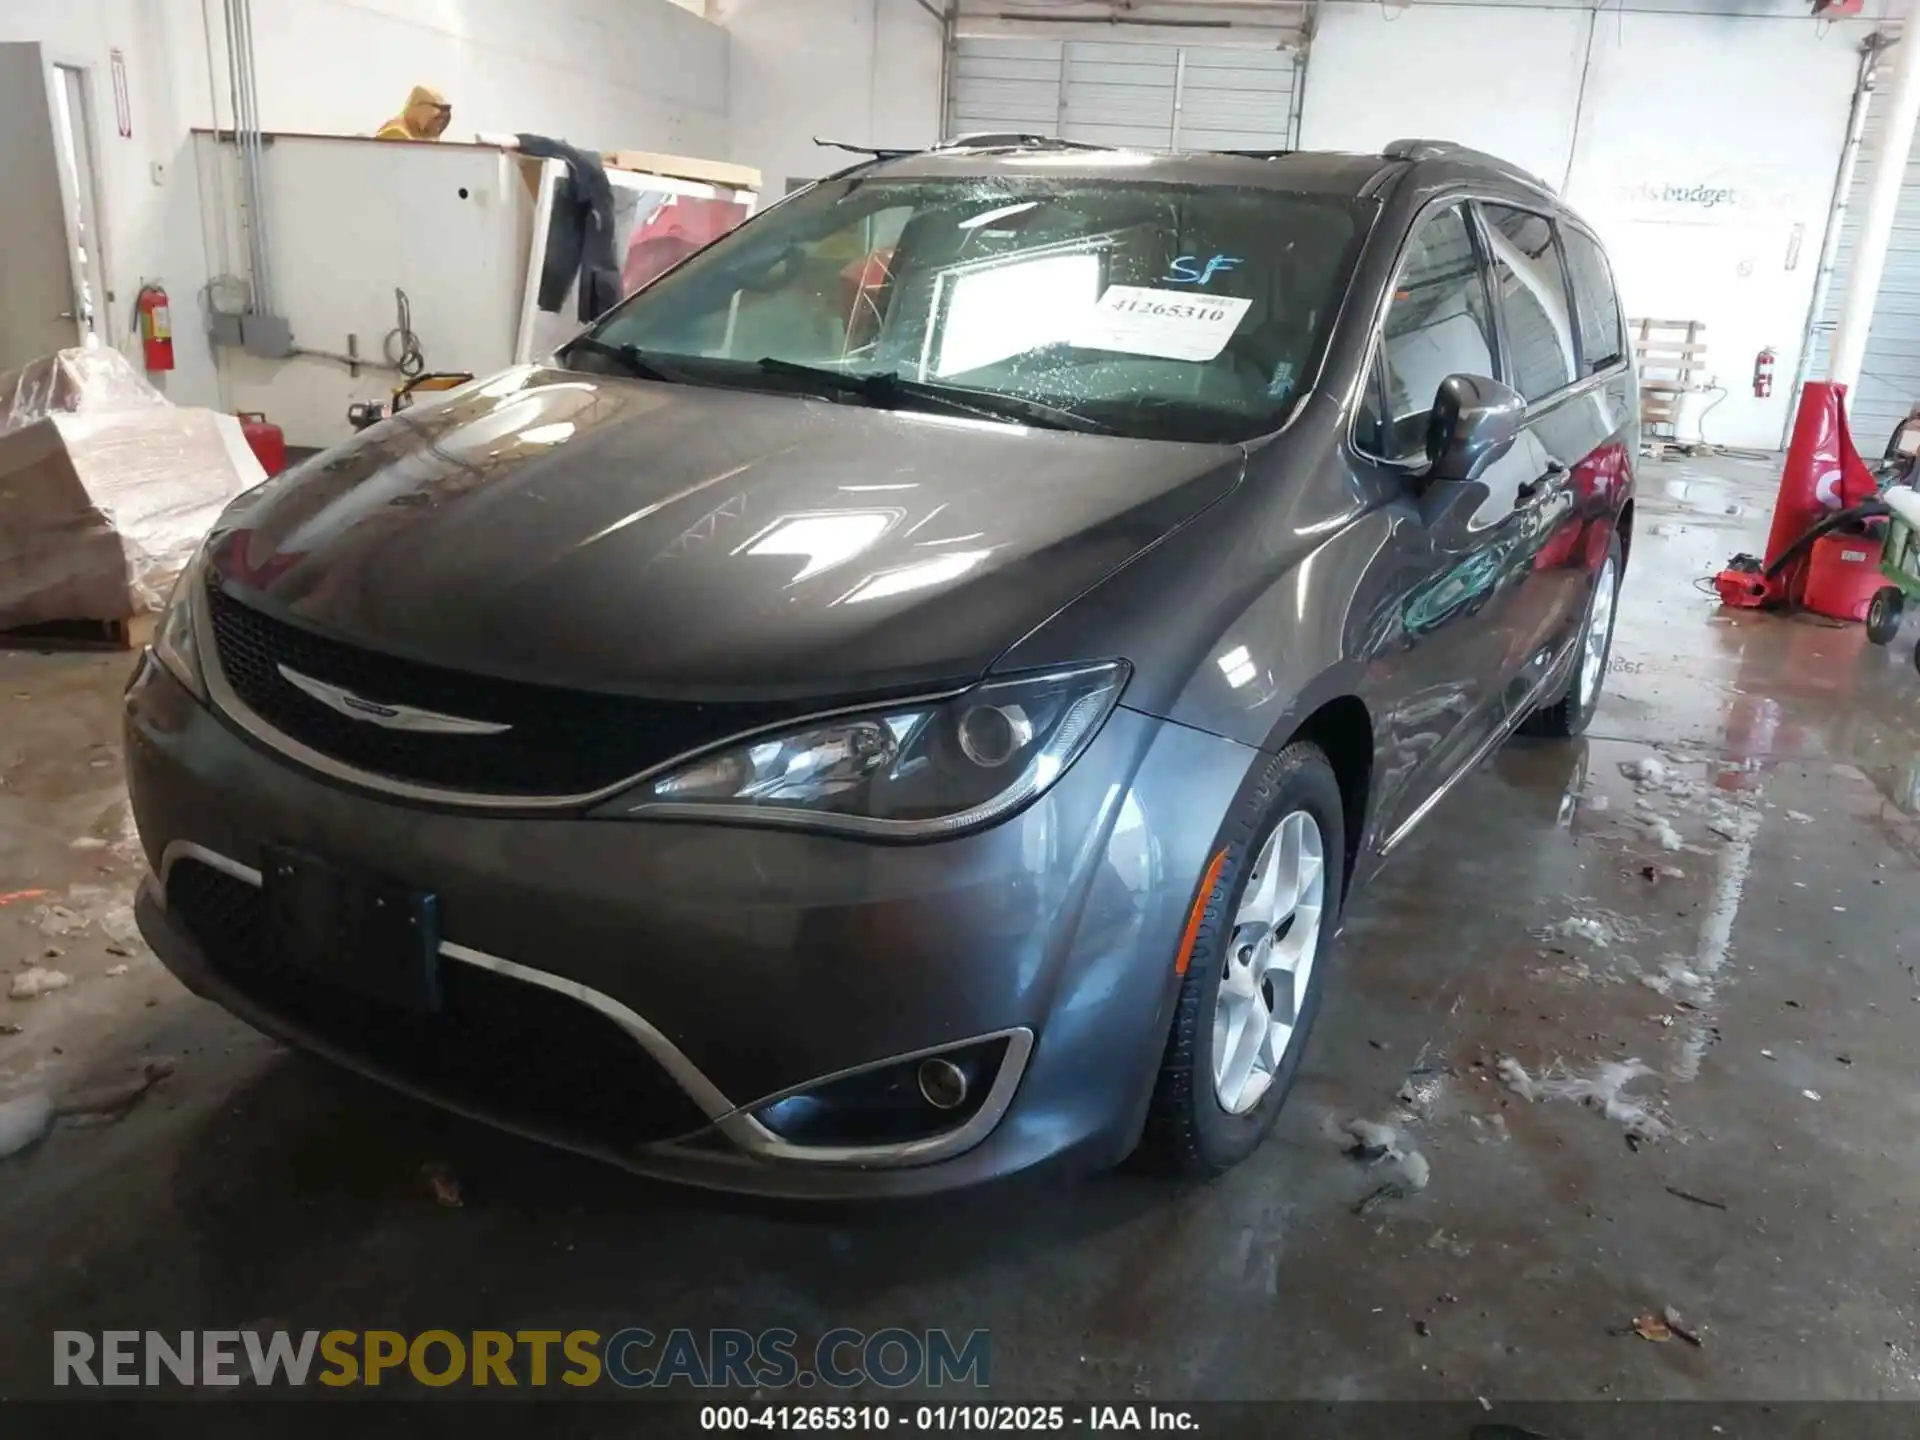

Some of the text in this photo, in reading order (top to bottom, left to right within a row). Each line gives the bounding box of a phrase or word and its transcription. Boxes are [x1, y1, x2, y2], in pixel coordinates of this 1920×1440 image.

[1662, 183, 1736, 208] budget
[1162, 254, 1245, 285] SF
[1111, 298, 1225, 322] 41265310
